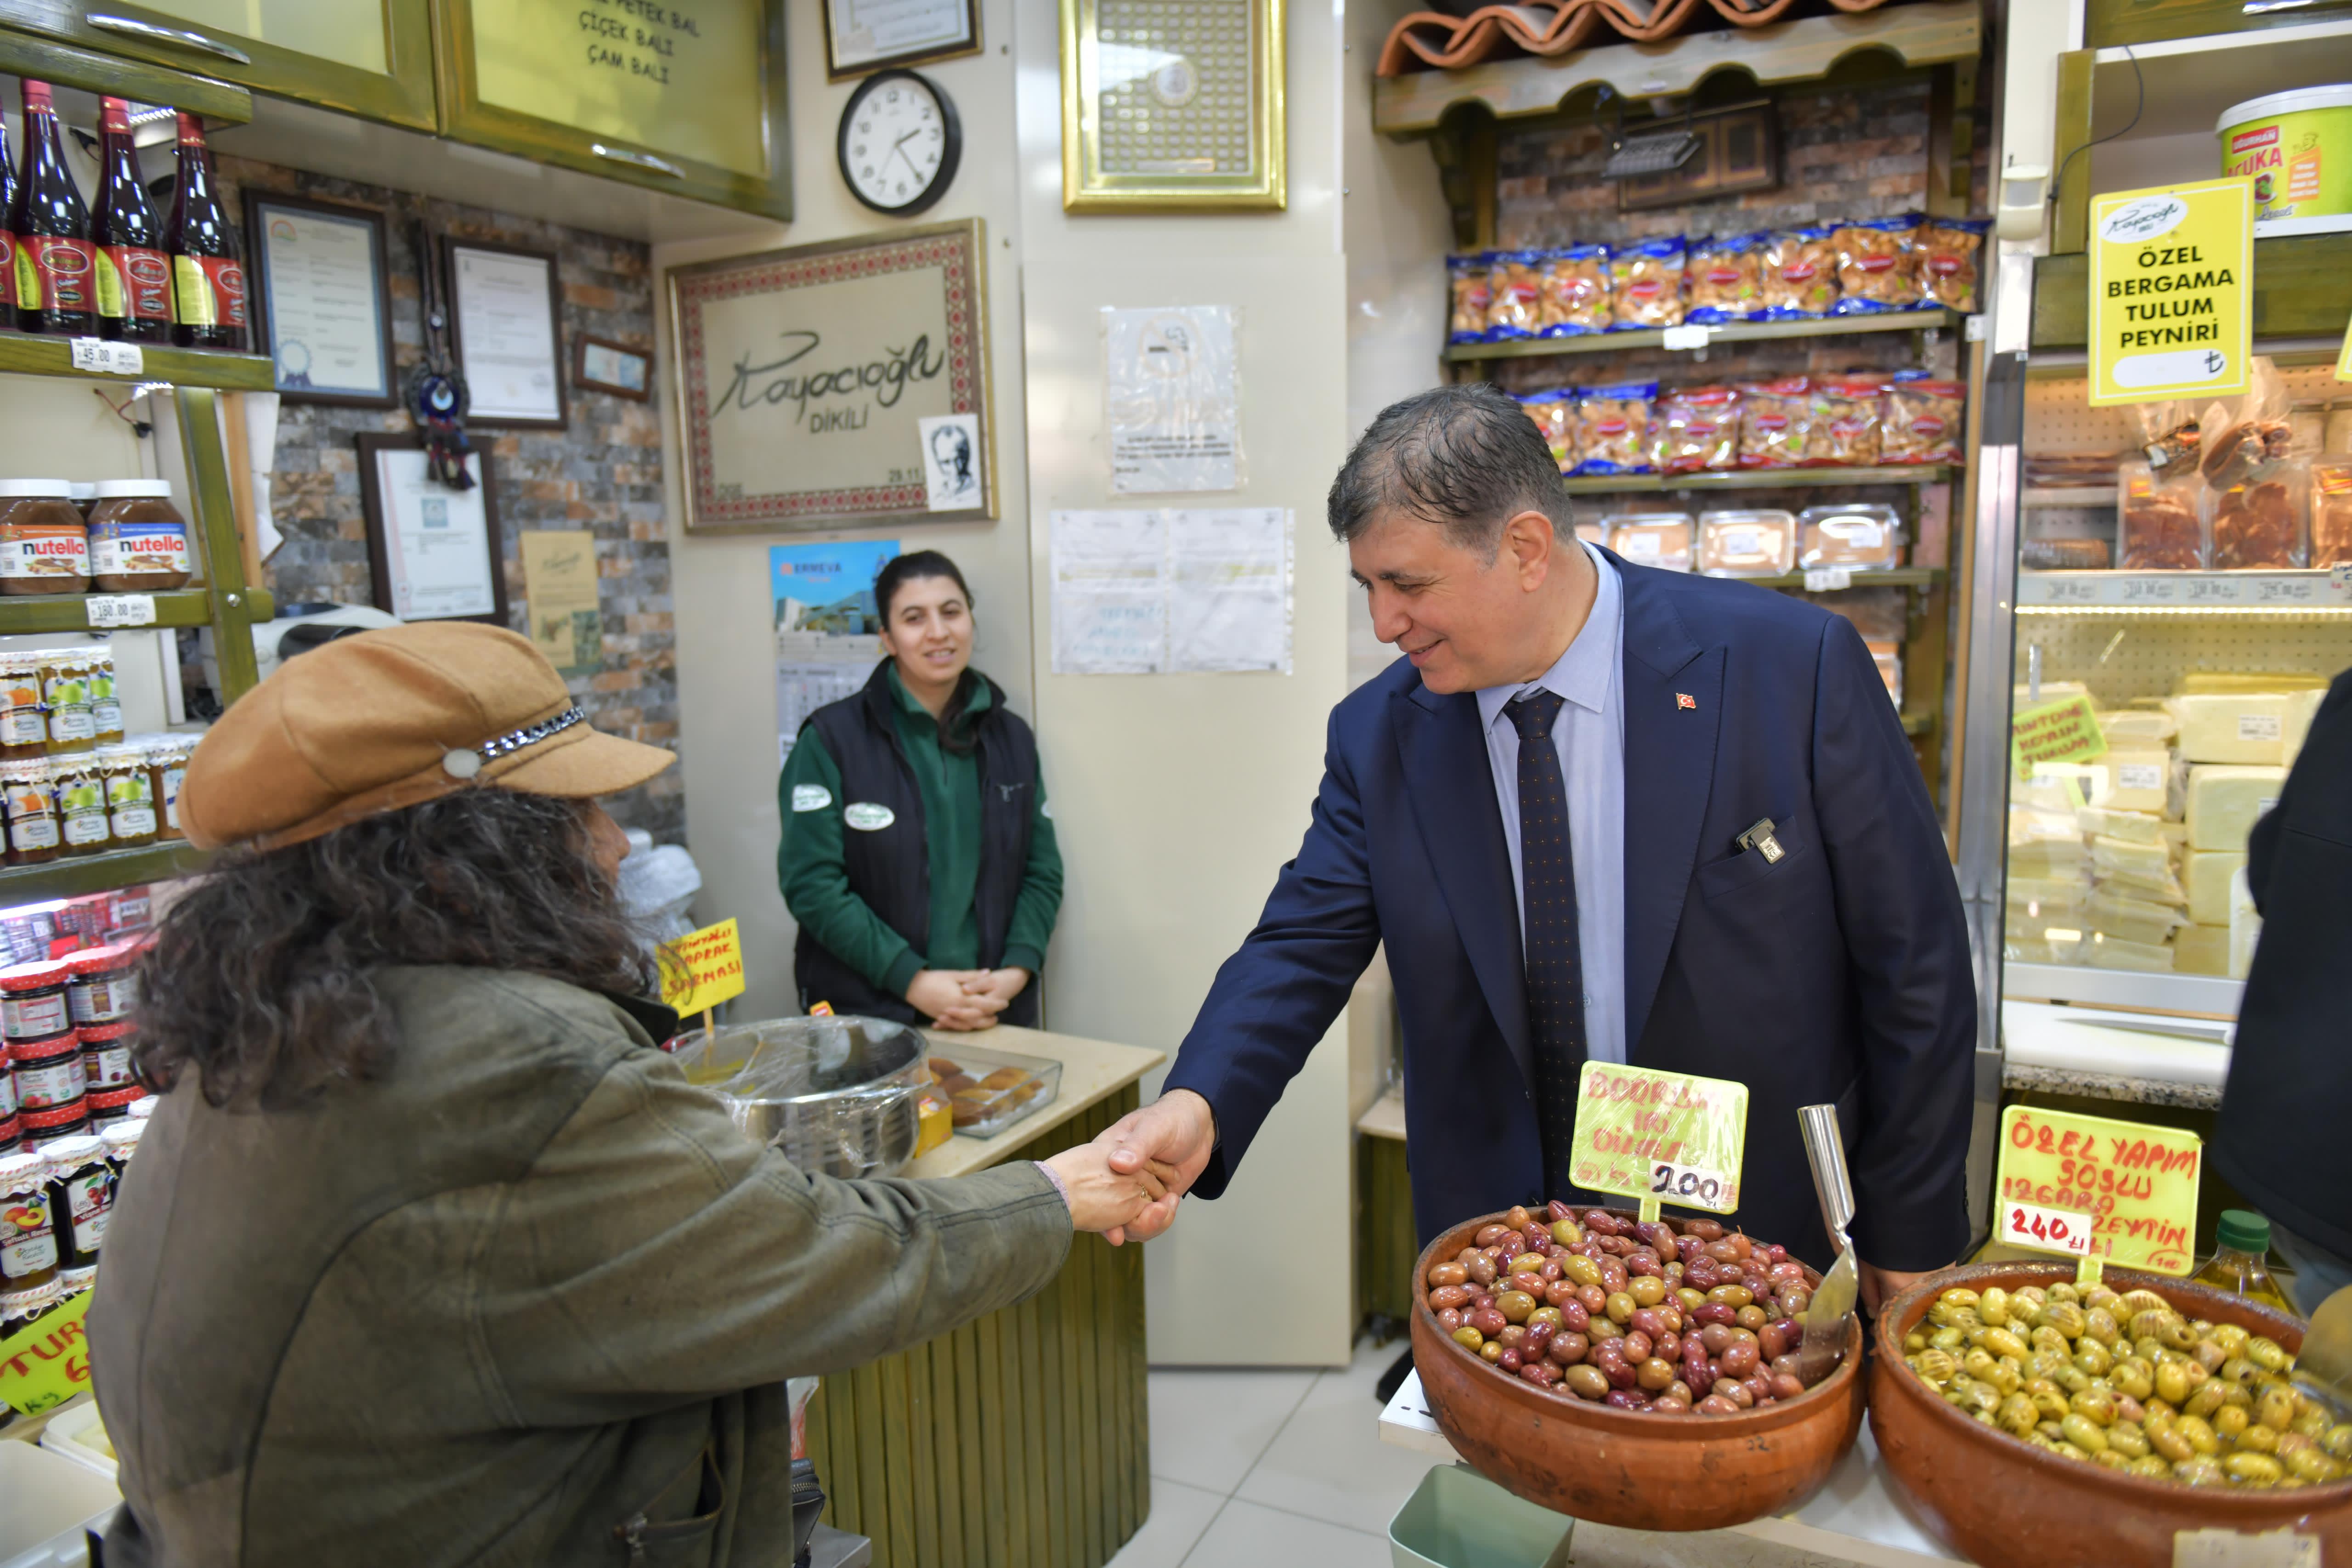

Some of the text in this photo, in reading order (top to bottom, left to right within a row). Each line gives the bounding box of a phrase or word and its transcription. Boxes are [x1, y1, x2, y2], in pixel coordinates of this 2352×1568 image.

[579, 9, 629, 41] ÇİÇEK
[671, 11, 701, 38] BAL
[588, 44, 625, 70] ÇAM
[2138, 246, 2203, 268] ÖZEL
[2108, 268, 2235, 298] BERGAMA
[2126, 297, 2213, 322] TULUM
[2121, 318, 2219, 349] PEYNİRİ
[711, 331, 944, 424] Kayacıoğlu
[811, 404, 868, 434] DİKİLİ
[22, 538, 85, 555] nutella
[120, 536, 184, 552] nutella
[2012, 1114, 2197, 1180] ÖZEL YAPIM
[1651, 1164, 1719, 1200] 200
[2058, 1159, 2151, 1200] SOSLU
[2012, 1208, 2069, 1241] 240
[0, 1312, 87, 1377] TUR
[65, 1353, 90, 1382] 6
